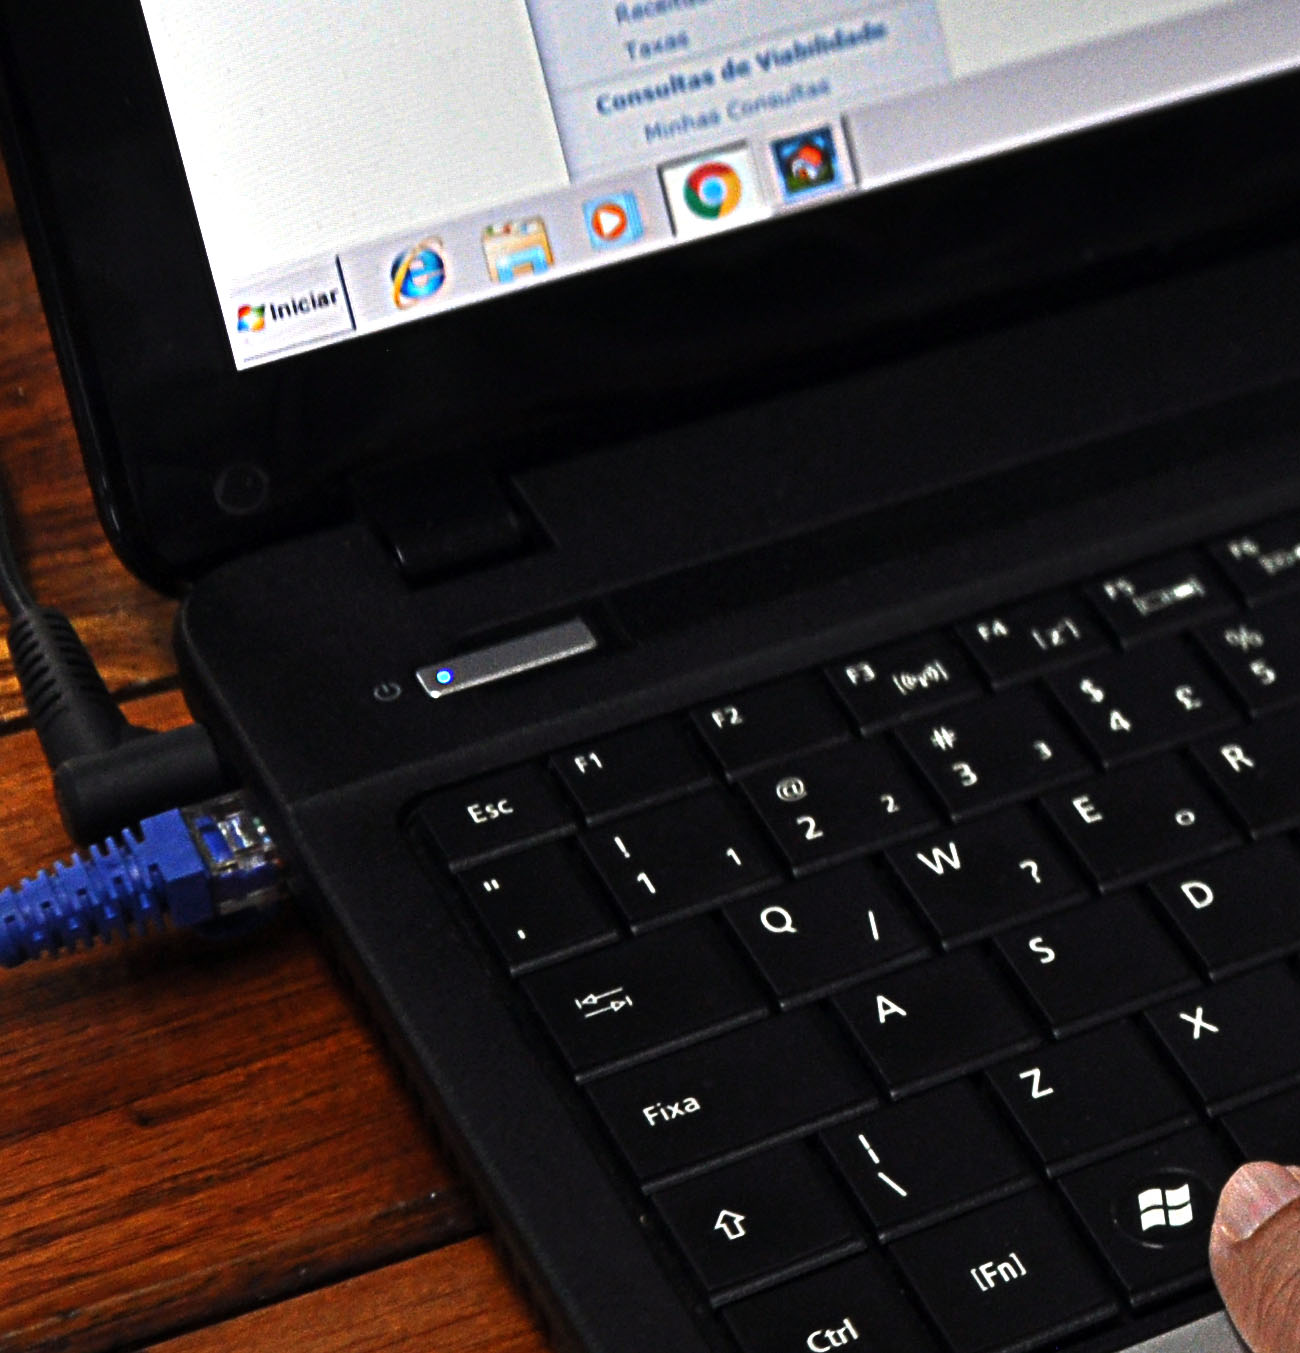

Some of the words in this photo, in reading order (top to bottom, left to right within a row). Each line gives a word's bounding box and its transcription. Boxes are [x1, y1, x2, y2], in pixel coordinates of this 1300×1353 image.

[624, 30, 691, 62] Taxas
[595, 68, 717, 117] Consultas
[720, 56, 752, 81] de
[754, 19, 889, 74] Viabilidade
[643, 108, 722, 144] Minhas
[726, 77, 832, 123] Consultas
[269, 286, 339, 323] Iniciar
[845, 661, 877, 685] F3
[1250, 659, 1277, 686] 5
[1079, 677, 1105, 704] $
[710, 705, 744, 730] F2
[1109, 708, 1132, 733] 4
[929, 725, 958, 751] #
[573, 751, 604, 775] F1
[1220, 743, 1256, 774] R
[951, 760, 979, 788] 3
[775, 775, 808, 803] @
[466, 797, 515, 825] Esc
[1072, 793, 1105, 825] E
[795, 814, 825, 841] 2
[612, 835, 632, 860] !
[915, 843, 961, 876] W
[636, 871, 657, 895] 1
[1018, 858, 1043, 885] ?
[1180, 880, 1215, 911] D
[759, 905, 798, 935] Q
[1028, 936, 1056, 965] S
[874, 994, 907, 1024] A
[1178, 1005, 1220, 1040] X
[1018, 1066, 1054, 1100] Z
[642, 1095, 702, 1127] Fixa
[969, 1252, 1028, 1293] [Fn]
[805, 1316, 860, 1353] Ctrl
